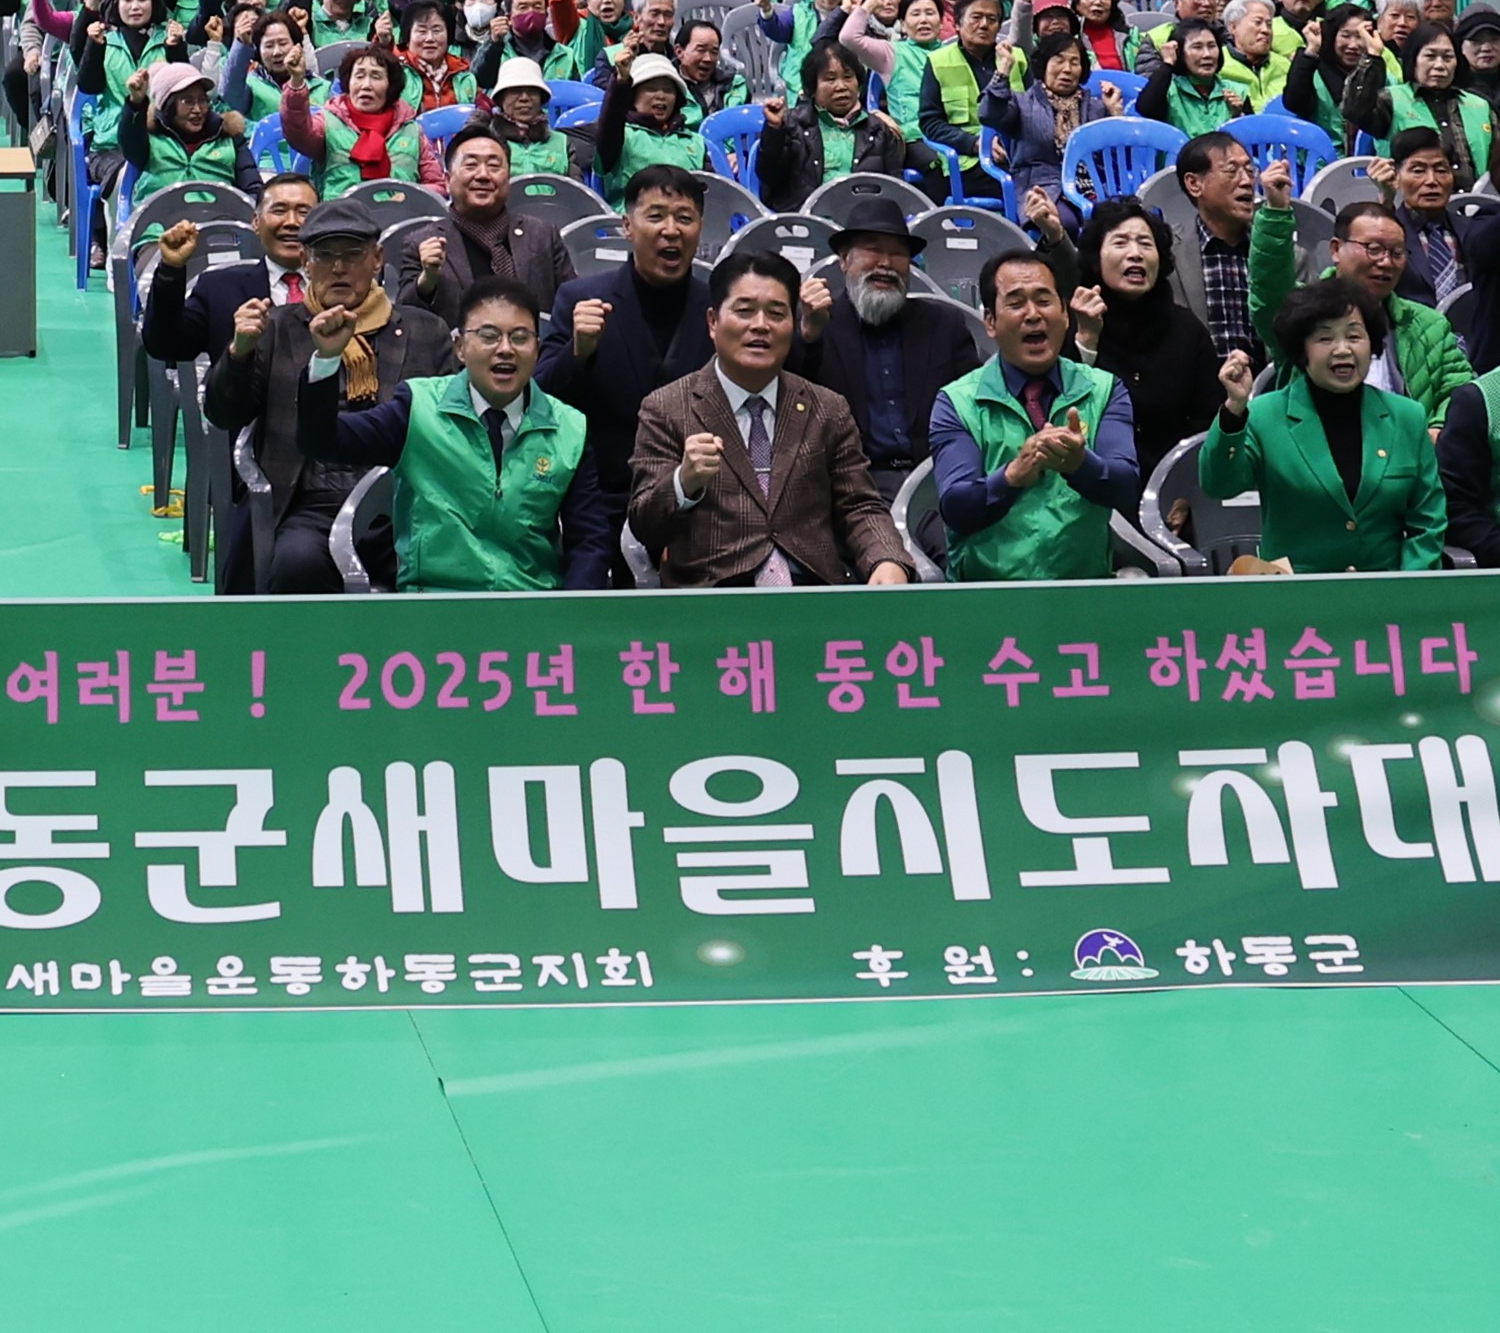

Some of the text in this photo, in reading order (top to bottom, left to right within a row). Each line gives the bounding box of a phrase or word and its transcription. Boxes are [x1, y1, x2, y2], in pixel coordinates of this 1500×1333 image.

[7, 650, 204, 723] 여러분
[339, 644, 577, 715] 2025년
[620, 641, 680, 714] 한
[717, 641, 775, 712] 해
[817, 637, 944, 712] 동안
[983, 638, 1109, 706] 수고
[1146, 623, 1477, 702] 하셨습니다
[5, 947, 655, 997] 새마을운동하동군지회
[1175, 934, 1364, 976] 하동군
